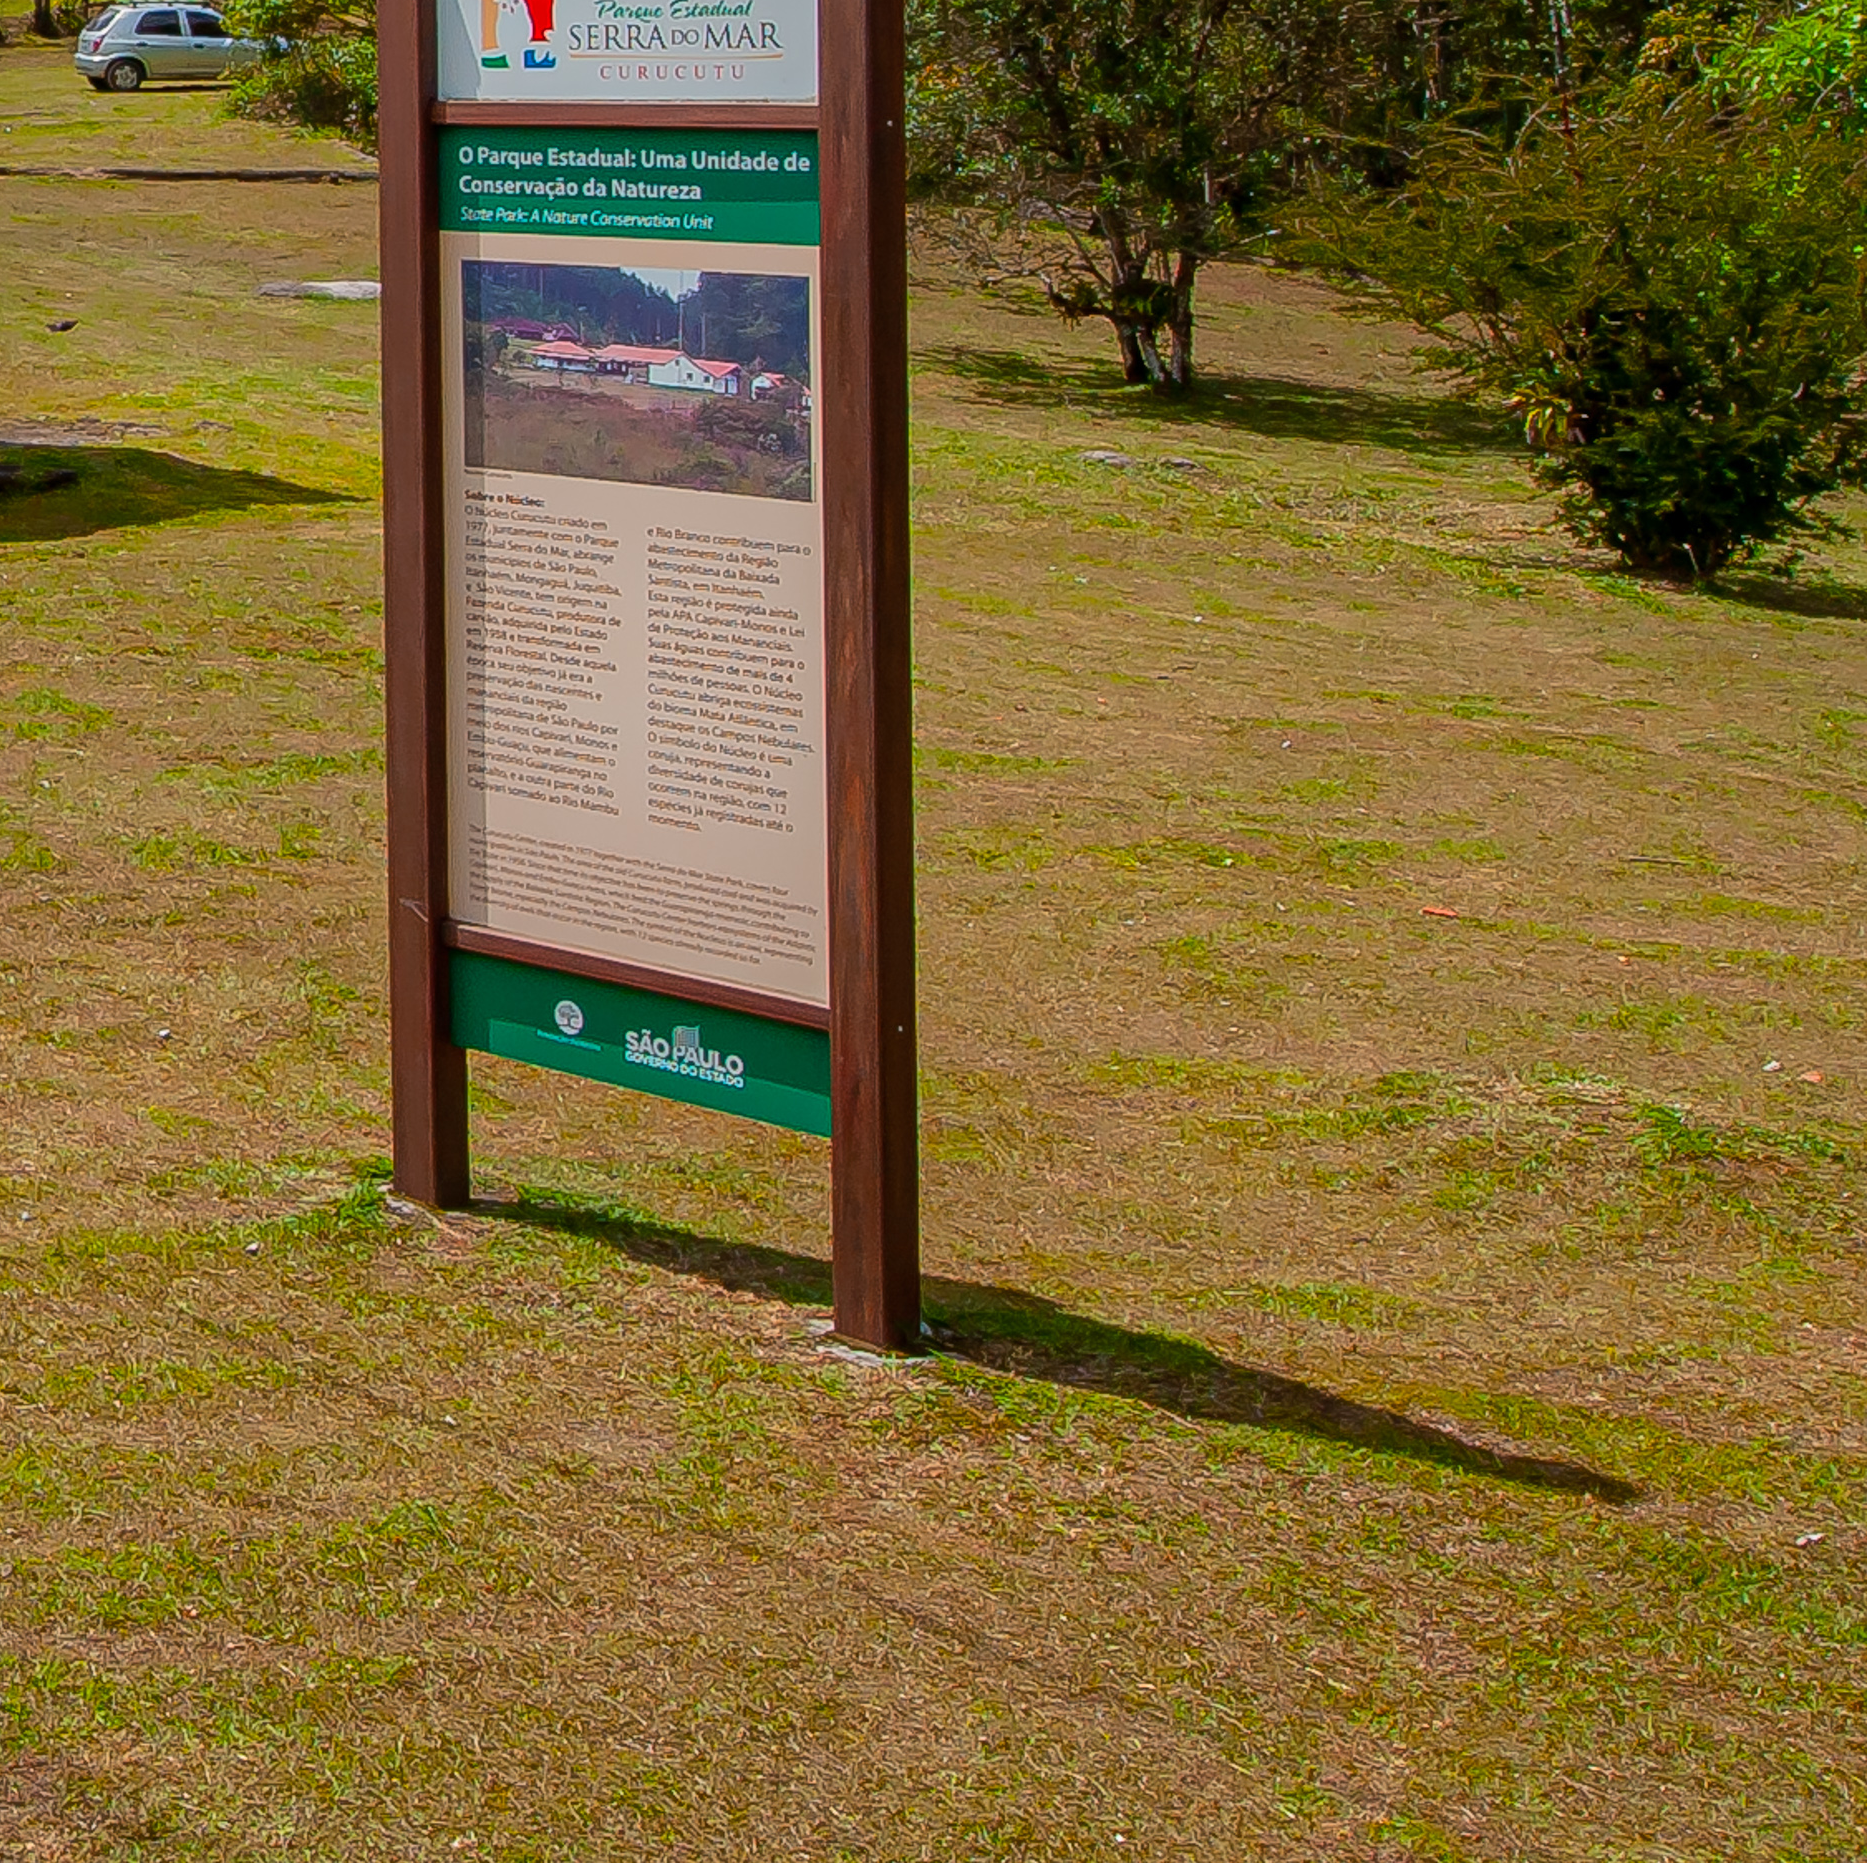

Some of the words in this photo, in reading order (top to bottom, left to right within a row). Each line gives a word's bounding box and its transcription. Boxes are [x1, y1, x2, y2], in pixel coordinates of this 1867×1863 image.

[594, 0, 663, 23] Parque
[569, 24, 667, 50] SERRA
[671, 29, 699, 45] DO
[705, 22, 784, 49] MAR
[599, 65, 745, 79] CURUCUTU
[459, 147, 473, 165] O
[478, 147, 543, 169] Parque
[548, 147, 635, 168] Estadual:
[641, 150, 687, 169] Uma
[692, 150, 779, 171] Unidade
[784, 151, 811, 171] de
[459, 176, 578, 201] Conservação
[583, 177, 607, 196] da
[612, 179, 701, 199] Natureza
[461, 207, 493, 221] State
[530, 209, 541, 223] A
[543, 209, 588, 224] Nature
[591, 211, 680, 228] Conservation
[683, 213, 713, 230] Unit
[625, 1029, 669, 1058] SÃO
[673, 1046, 743, 1075] PAULO
[625, 1051, 679, 1073] GOVERNO
[679, 1063, 697, 1076] DO
[699, 1068, 743, 1087] ESTADO
